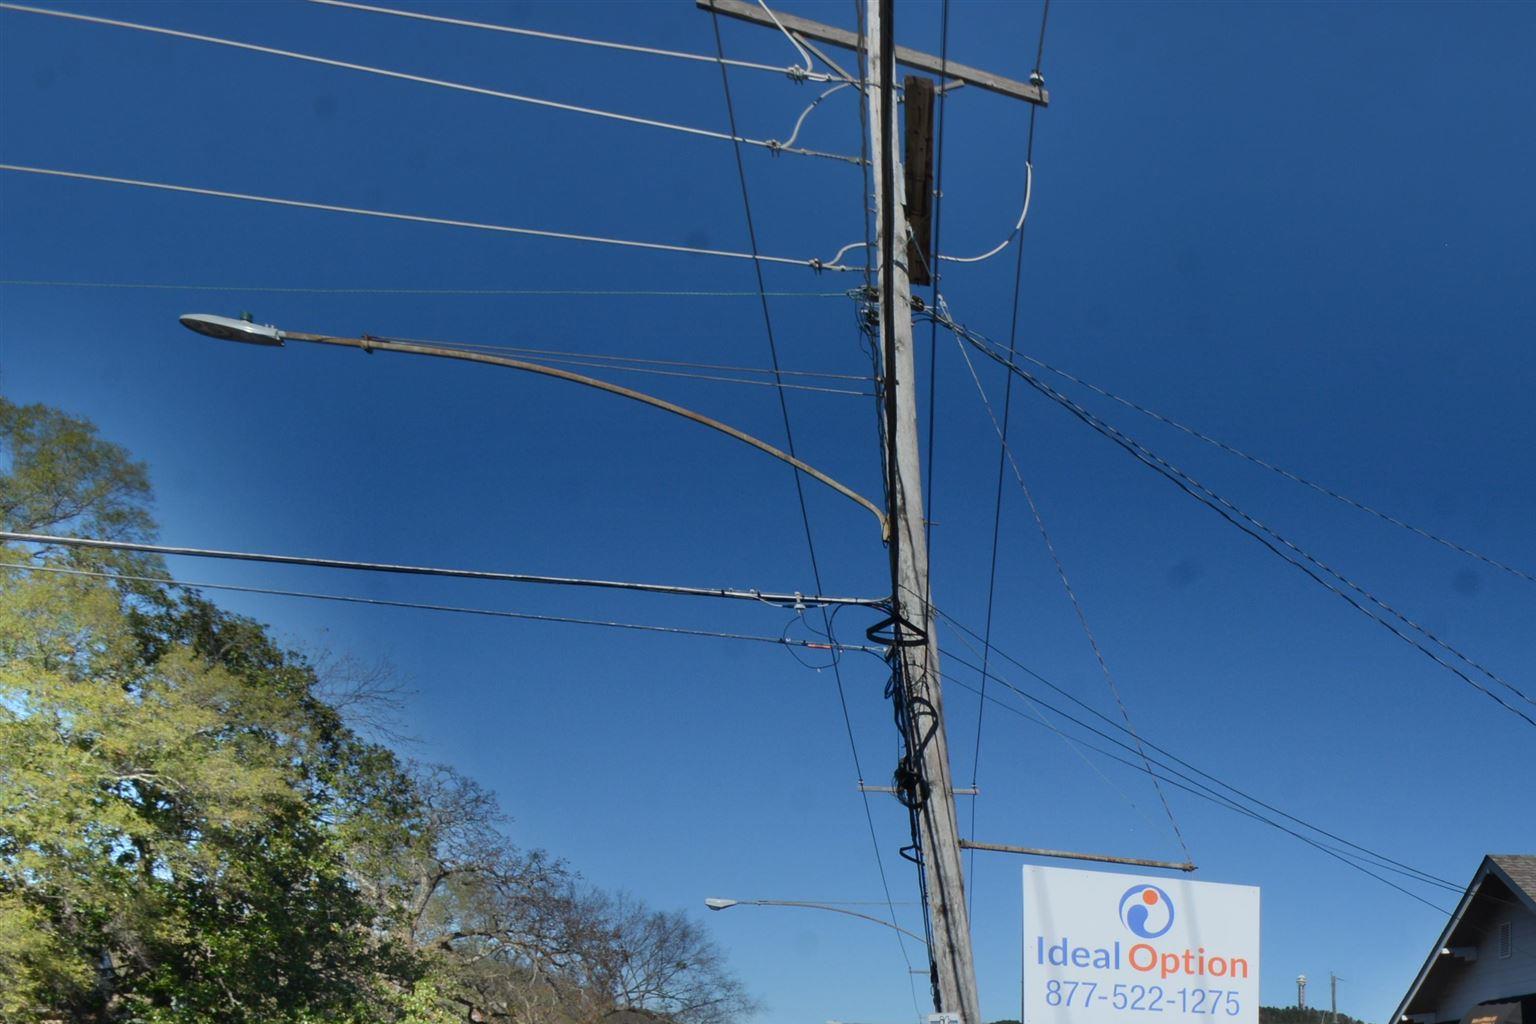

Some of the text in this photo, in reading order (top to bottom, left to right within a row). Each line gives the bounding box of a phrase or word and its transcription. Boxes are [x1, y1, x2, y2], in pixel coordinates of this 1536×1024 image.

[1037, 936, 1249, 979] Ideal Option
[1045, 979, 1241, 1017] 877-522-1275
